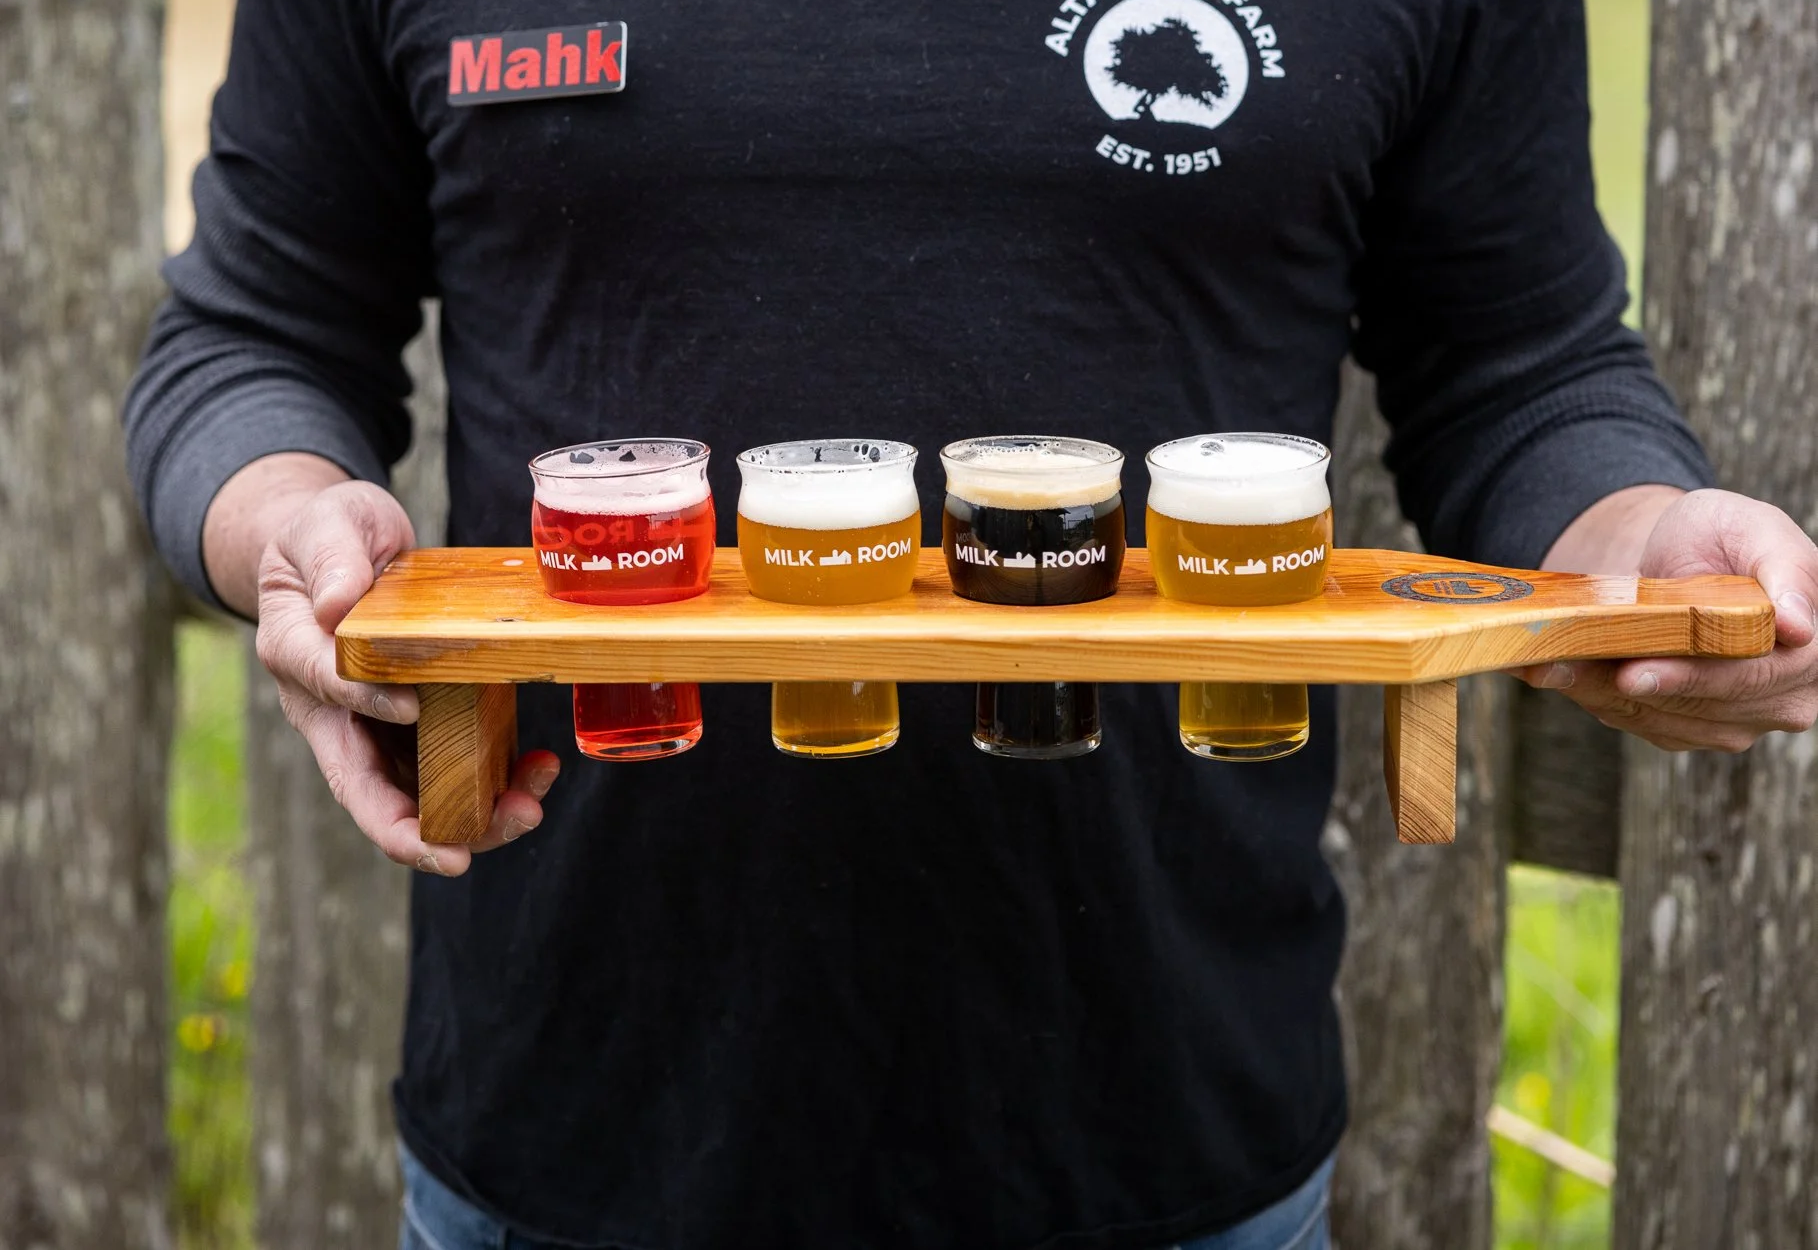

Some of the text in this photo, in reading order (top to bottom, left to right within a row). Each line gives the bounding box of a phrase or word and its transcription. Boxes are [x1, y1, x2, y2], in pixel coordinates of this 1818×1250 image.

[449, 30, 622, 94] Mahk
[1095, 134, 1222, 175] EST. 1951
[540, 543, 684, 571] MILK ROOM
[764, 537, 912, 567] MILK ROOM
[955, 543, 1106, 568] MILK ROOM
[1177, 544, 1325, 575] MILK ROOM
